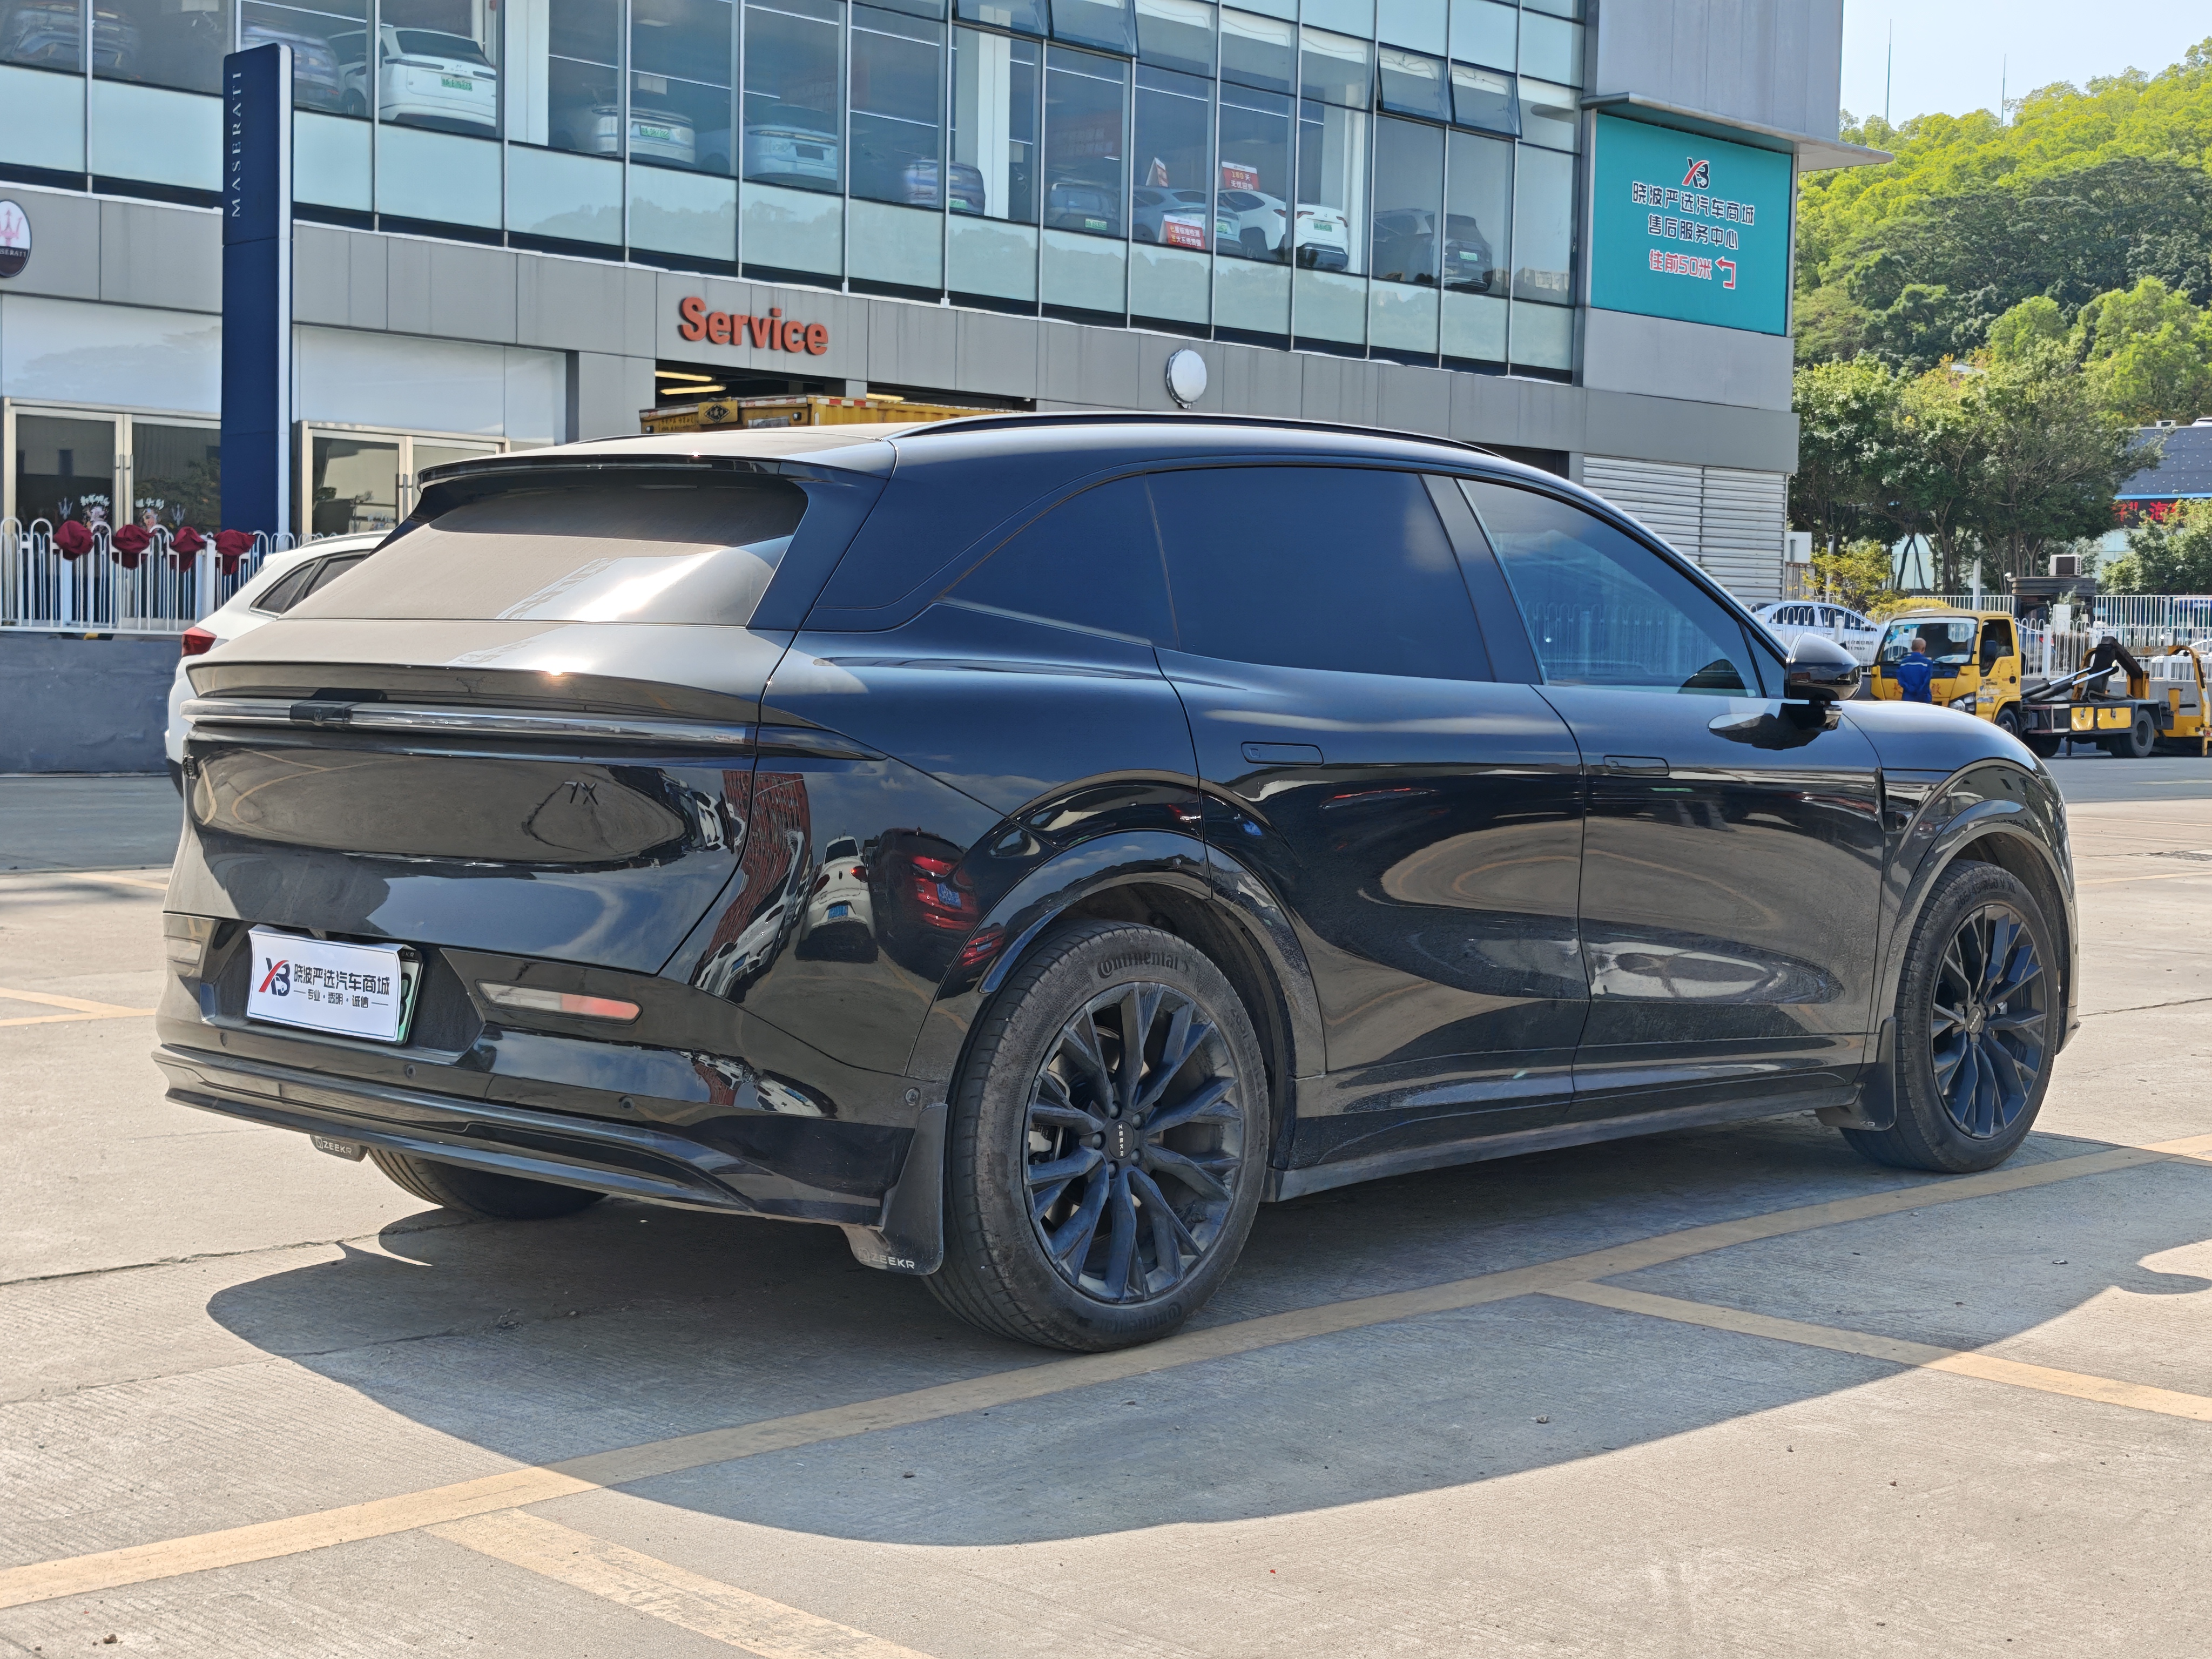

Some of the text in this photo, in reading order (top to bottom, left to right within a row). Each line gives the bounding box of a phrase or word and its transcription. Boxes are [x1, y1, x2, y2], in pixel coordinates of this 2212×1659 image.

[232, 72, 242, 217] MASERATI
[1632, 181, 1754, 225] 晓波严选汽车商城
[1648, 214, 1738, 249] 售后服务中心
[0, 249, 26, 258] SERATI
[679, 296, 828, 356] Service
[294, 963, 390, 996] 晓波严选汽车商城
[1097, 952, 1178, 979] Continental
[323, 1141, 352, 1155] ZEEKR
[870, 1252, 915, 1270] ZEEKR
